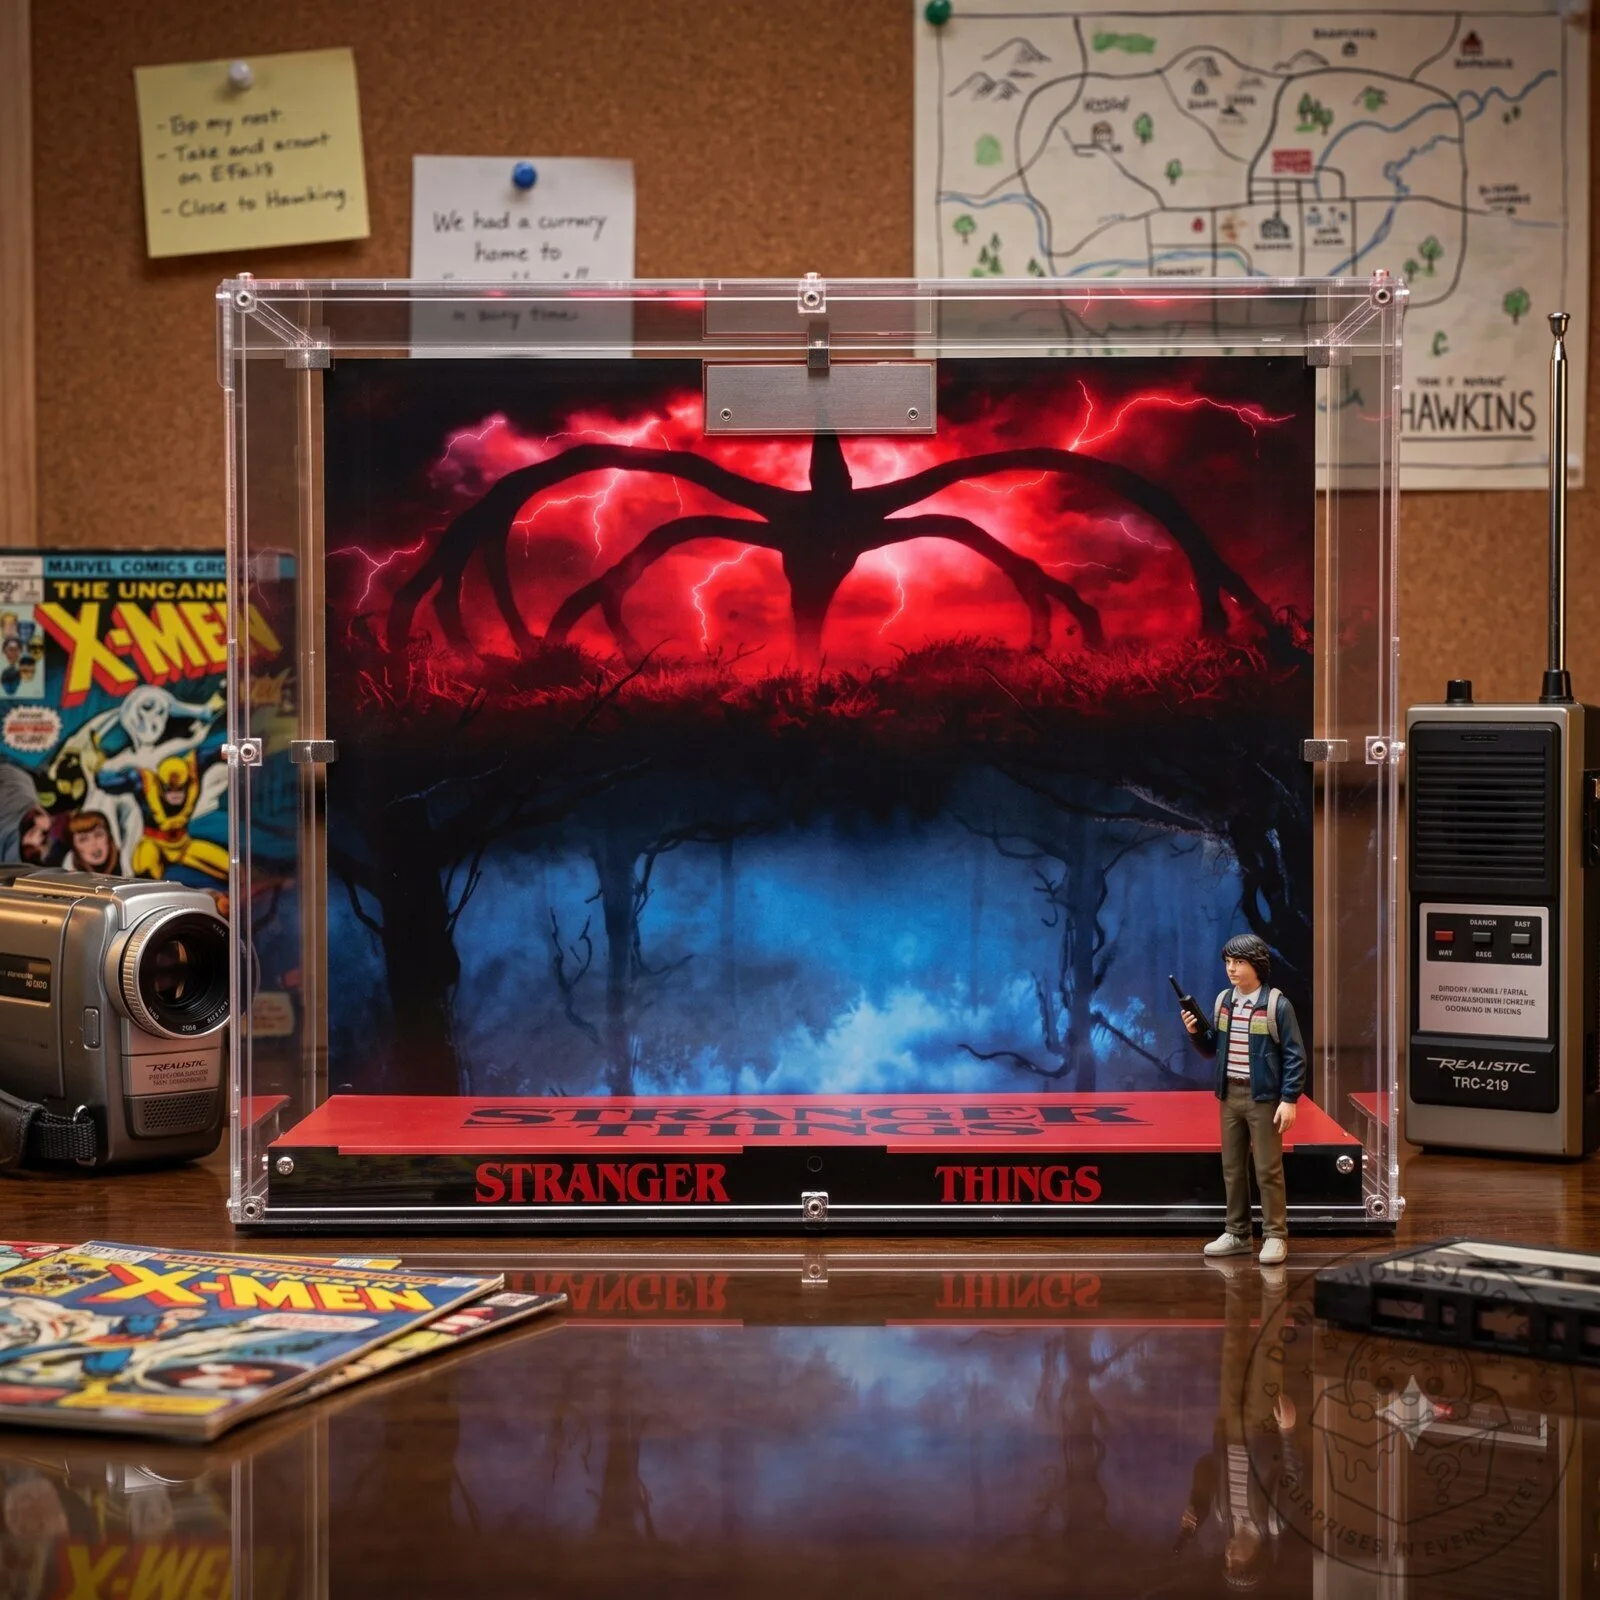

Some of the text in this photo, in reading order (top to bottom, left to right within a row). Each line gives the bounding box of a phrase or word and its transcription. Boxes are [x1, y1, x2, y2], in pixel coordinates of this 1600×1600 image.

[173, 143, 220, 162] Take
[228, 136, 265, 157] and
[177, 198, 228, 218] Close
[237, 194, 258, 213] to
[432, 207, 465, 234] We
[472, 209, 511, 230] had
[517, 217, 532, 230] a
[473, 240, 563, 263] home to
[1400, 390, 1537, 432] HAWKINS
[48, 560, 114, 575] MARVEL
[120, 560, 187, 575] COMICS
[193, 560, 227, 574] GRO
[53, 581, 109, 599] THE
[34, 602, 283, 708] X-MEN
[145, 1059, 208, 1072] REALISTIC
[1426, 1056, 1537, 1075] REALISTIC
[1452, 1076, 1509, 1091] TRC-219
[461, 1104, 1153, 1128] STRANGER
[578, 1122, 1045, 1137] THINGS
[475, 1163, 1102, 1202] STRANGER THINGS
[80, 1263, 436, 1311] X-MEN
